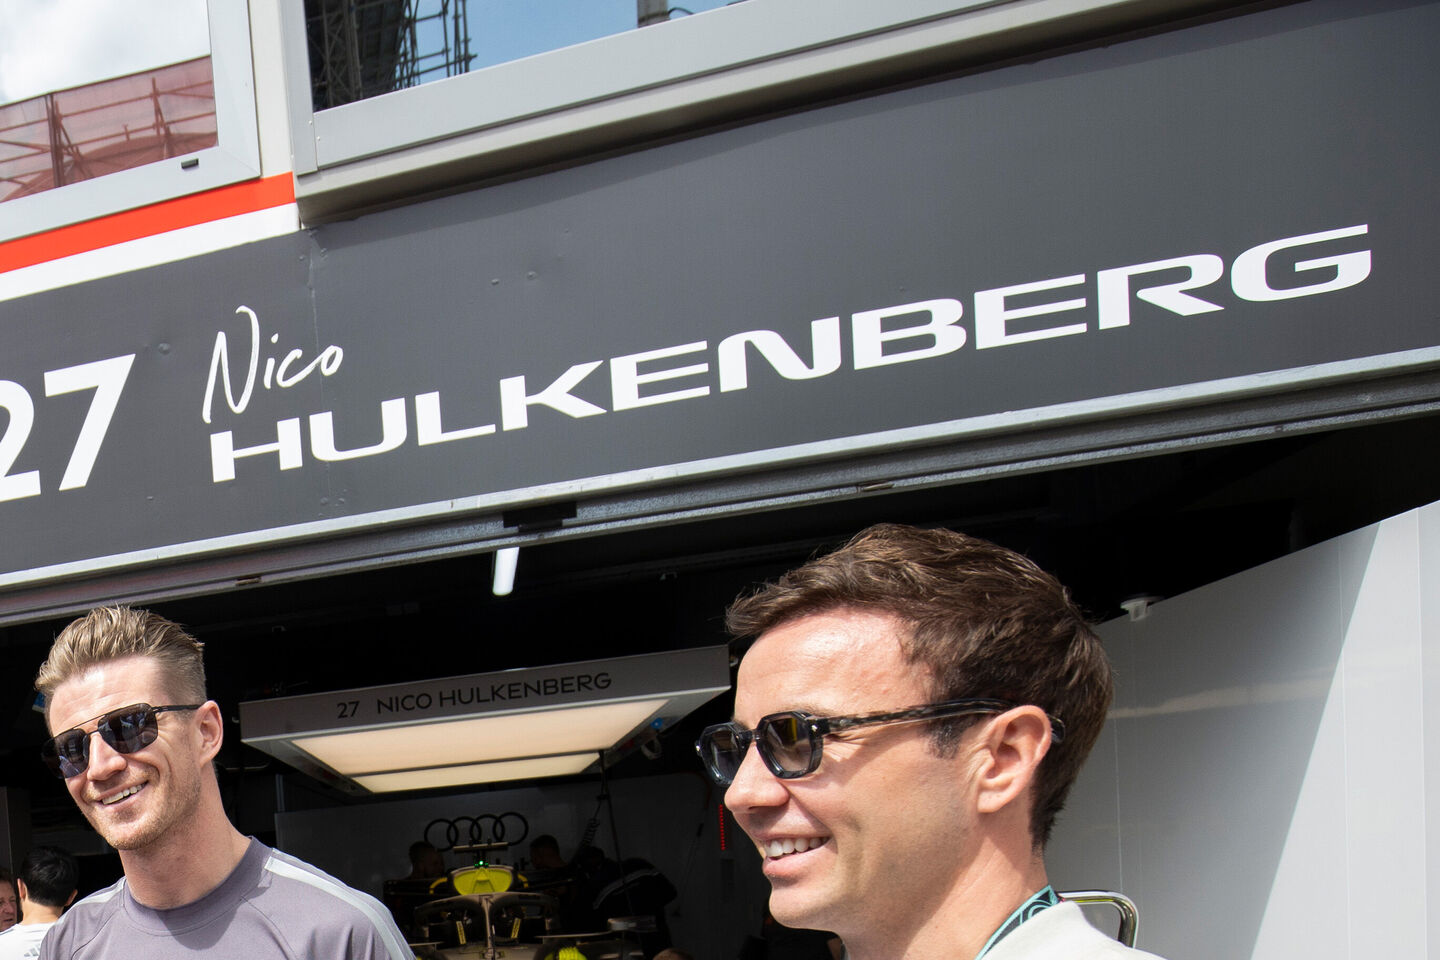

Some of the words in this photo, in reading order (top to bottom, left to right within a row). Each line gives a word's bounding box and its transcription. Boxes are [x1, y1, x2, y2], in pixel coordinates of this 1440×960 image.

[202, 305, 344, 424] Nico
[210, 224, 1372, 482] HULKENBERG
[336, 701, 360, 719] 27
[376, 693, 433, 714] NICO
[439, 672, 611, 707] HULKENBERG
